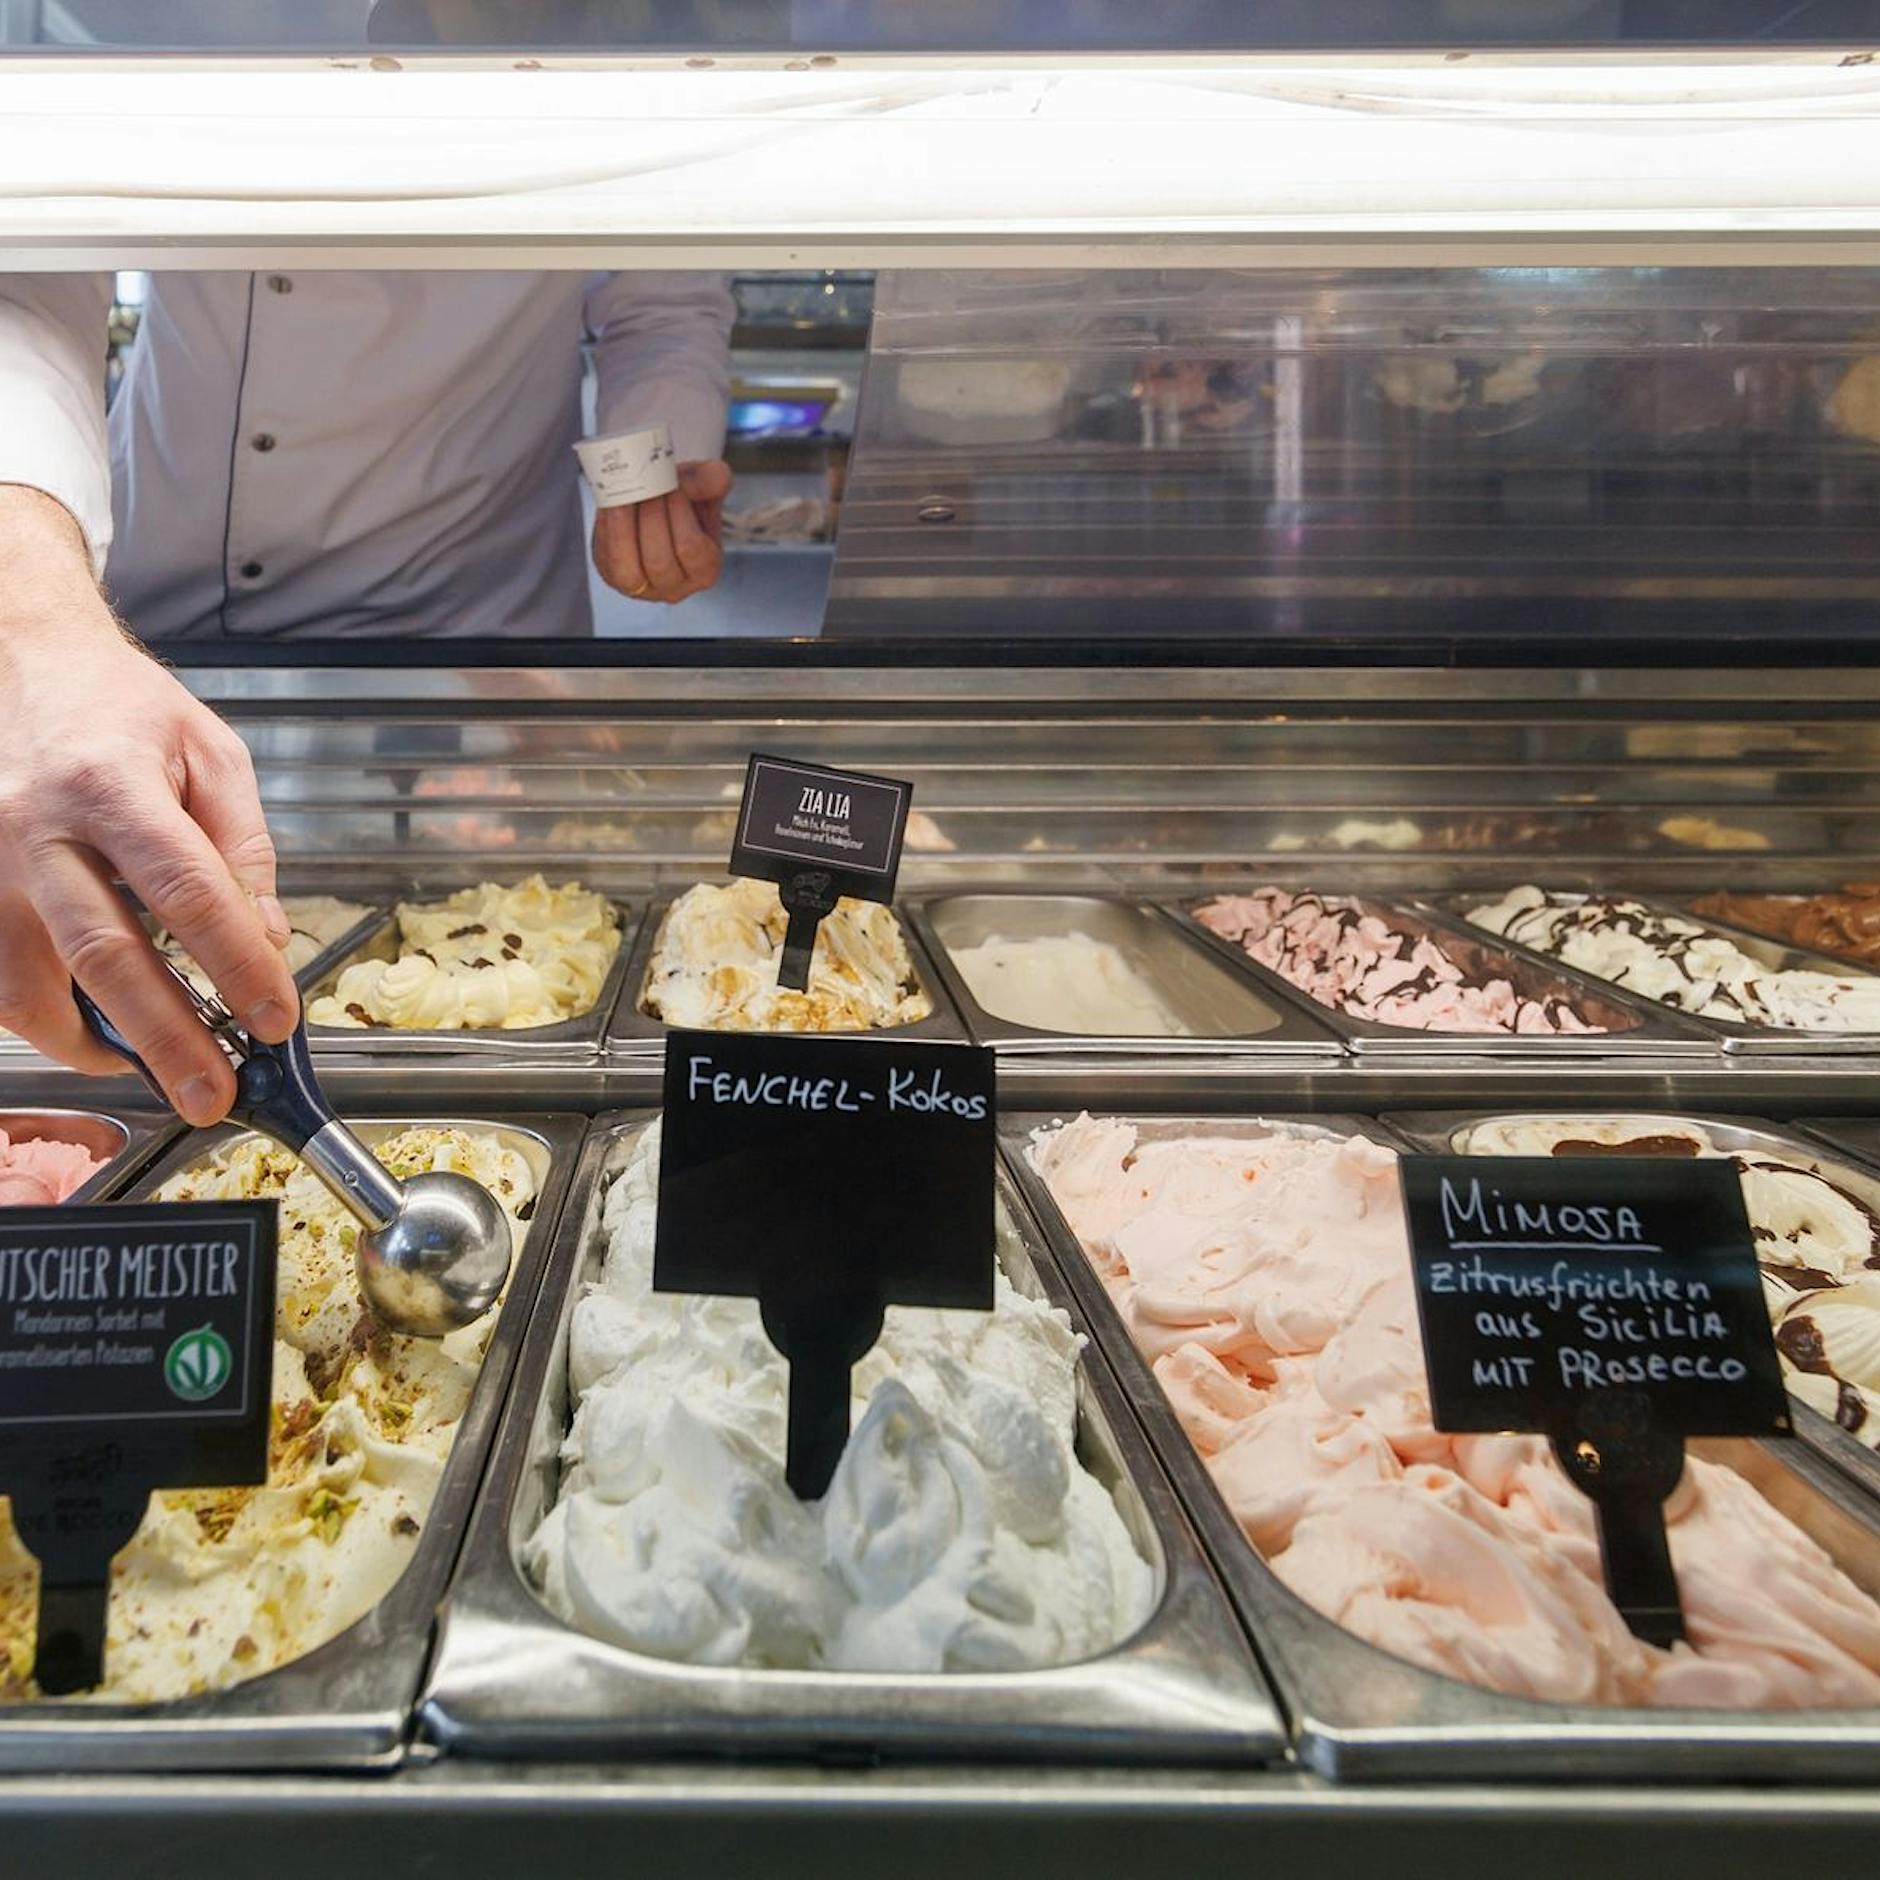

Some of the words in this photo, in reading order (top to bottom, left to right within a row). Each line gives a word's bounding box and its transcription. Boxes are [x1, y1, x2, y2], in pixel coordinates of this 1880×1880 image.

[798, 786, 824, 814] ZIA
[826, 791, 851, 820] LIA
[688, 1056, 876, 1112] FENCHEL-
[118, 1242, 240, 1299] MEISTER
[95, 1305, 140, 1332] Sorbet
[140, 1306, 166, 1331] mit
[1475, 1310, 1542, 1340] aus
[1472, 1357, 1536, 1388] MIT
